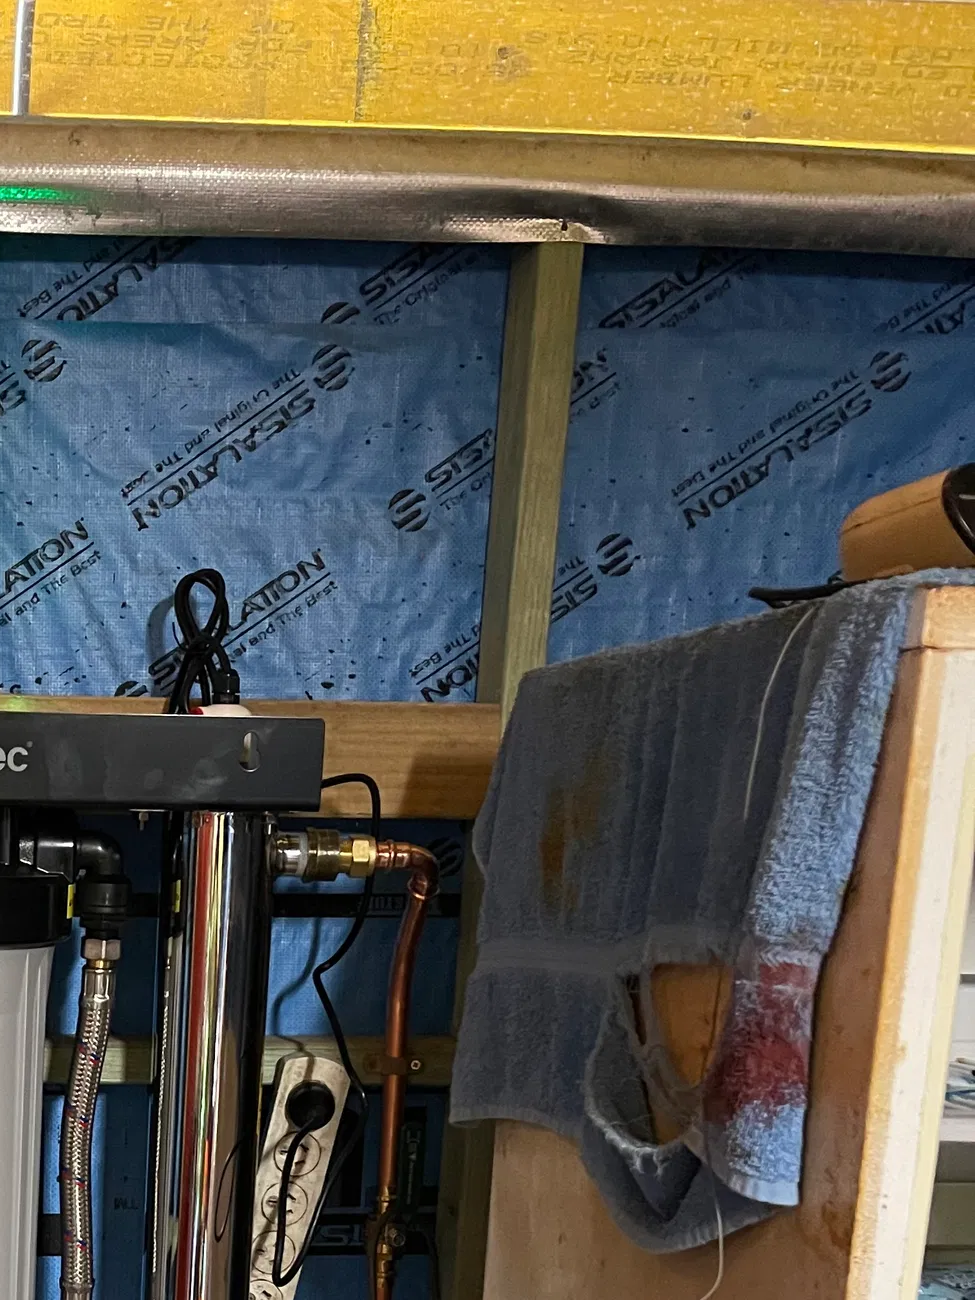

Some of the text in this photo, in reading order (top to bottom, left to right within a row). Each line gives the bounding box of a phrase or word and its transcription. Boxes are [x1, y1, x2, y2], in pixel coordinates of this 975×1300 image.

[131, 387, 316, 531] SISALATION
[683, 389, 873, 530] SISALATION
[557, 555, 586, 576] The
[15, 592, 41, 616] and
[41, 574, 69, 595] The
[249, 623, 275, 647] and
[276, 605, 303, 625] The
[444, 632, 471, 654] The
